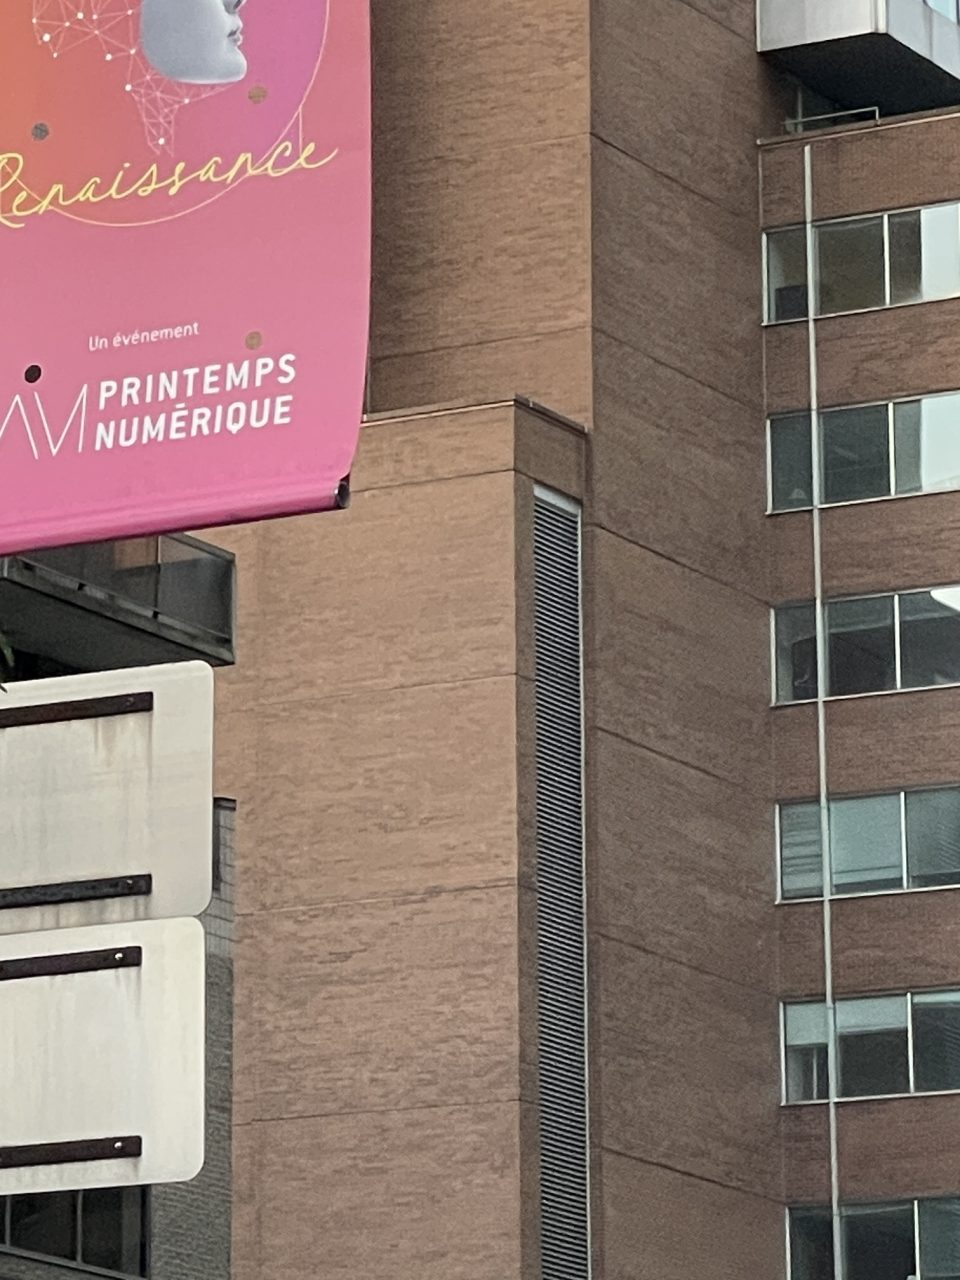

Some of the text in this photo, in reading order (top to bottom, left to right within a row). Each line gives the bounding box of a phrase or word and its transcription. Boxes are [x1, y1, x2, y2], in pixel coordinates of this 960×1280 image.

[88, 321, 200, 351] Un événement
[97, 353, 297, 410] PRINTEMPS
[93, 394, 294, 451] NUMÉRIQUE
